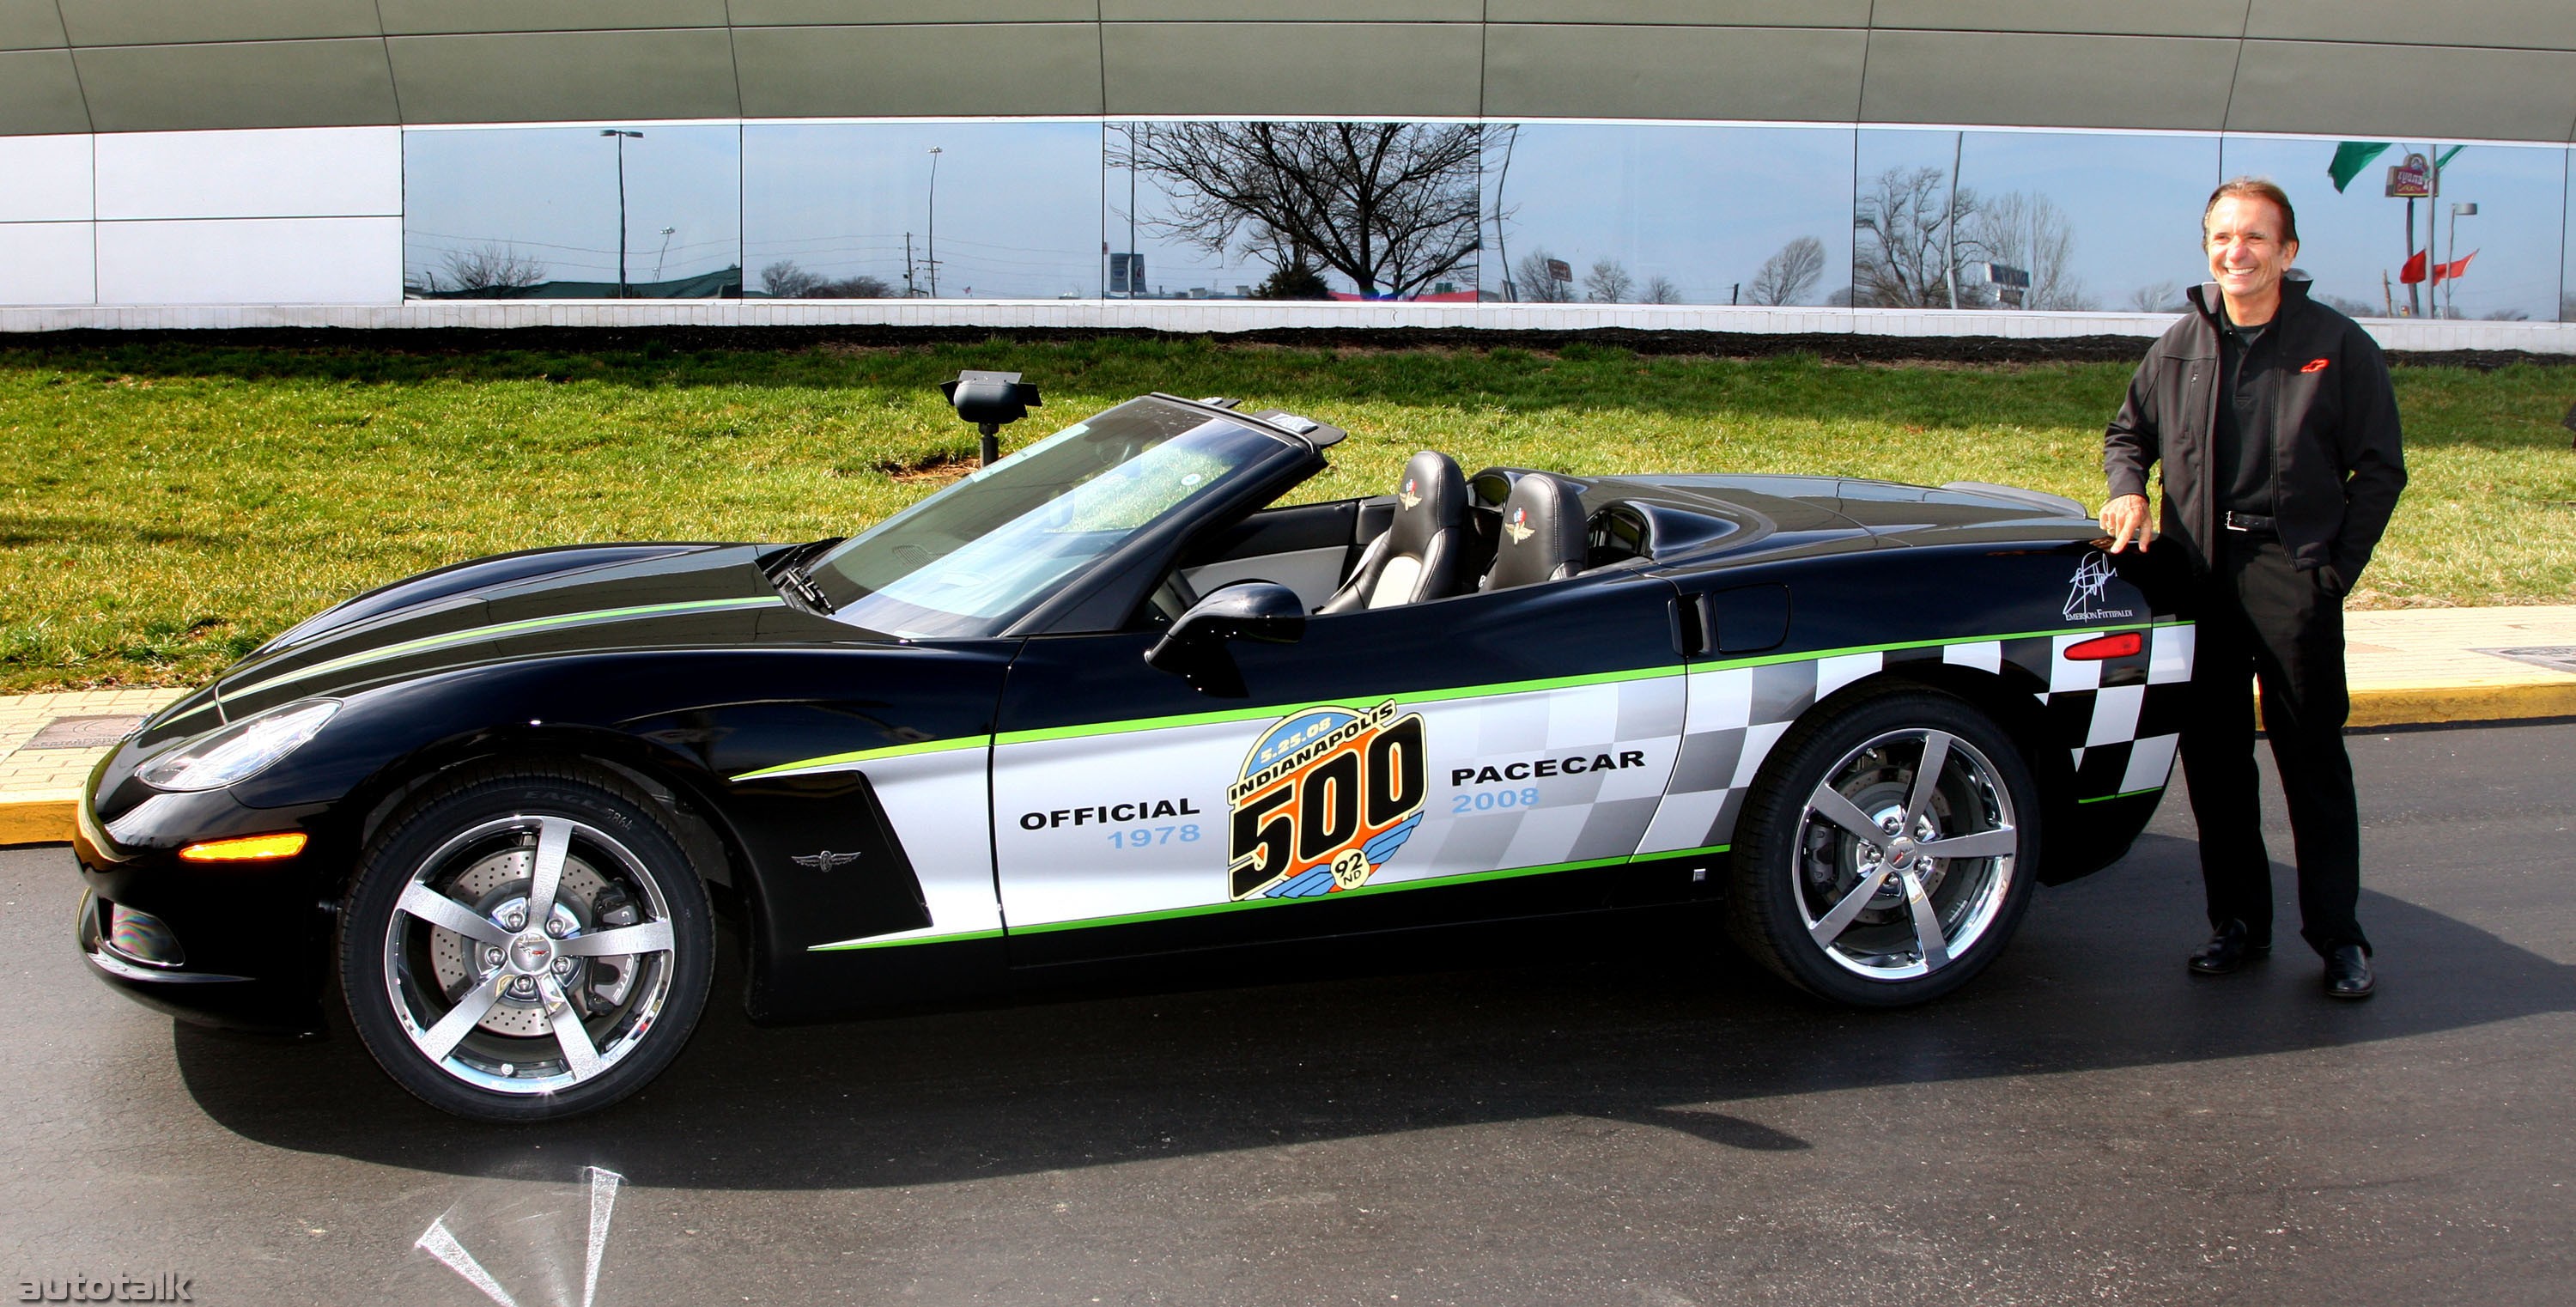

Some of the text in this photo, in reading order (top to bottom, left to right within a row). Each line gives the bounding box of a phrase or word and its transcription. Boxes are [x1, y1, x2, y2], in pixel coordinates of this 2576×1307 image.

[2065, 609, 2133, 622] EMERSON FITTIPALDI
[1230, 704, 1394, 801] INDIANAPOLIS
[1260, 716, 1332, 764] 5.25.08
[1452, 750, 1646, 787] PACECAR
[1019, 798, 1200, 830] OFFICIAL
[1232, 715, 1425, 898] 500
[1452, 787, 1540, 814] 2008
[1107, 824, 1200, 849] 1978
[1335, 852, 1363, 878] 92
[1343, 870, 1362, 886] ND
